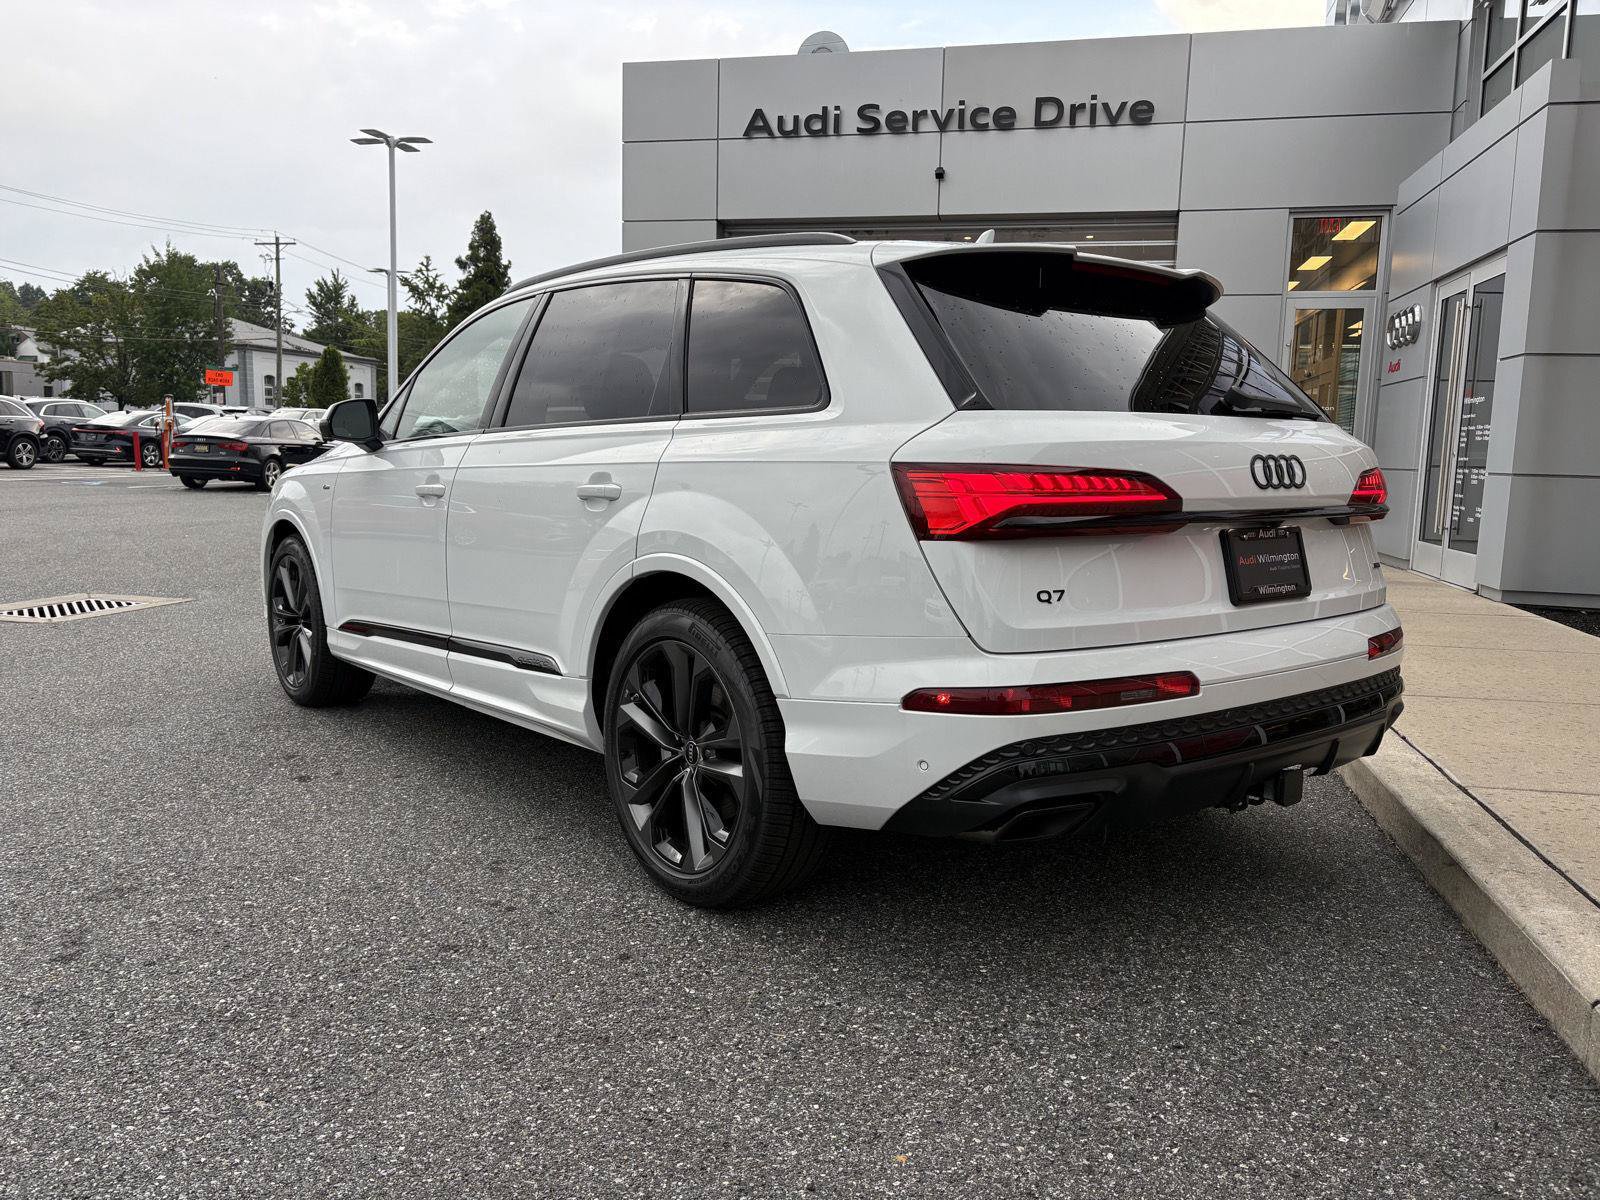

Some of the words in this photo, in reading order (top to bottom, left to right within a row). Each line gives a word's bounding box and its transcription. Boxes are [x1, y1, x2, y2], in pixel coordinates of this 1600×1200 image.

[742, 104, 841, 138] Audi
[856, 100, 1017, 133] Service
[1034, 94, 1156, 127] Drive
[1259, 529, 1276, 538] Audi
[1239, 554, 1256, 566] Audi
[1257, 553, 1299, 563] Wilmington
[1258, 584, 1296, 594] Wilmington
[1036, 589, 1066, 605] Q7
